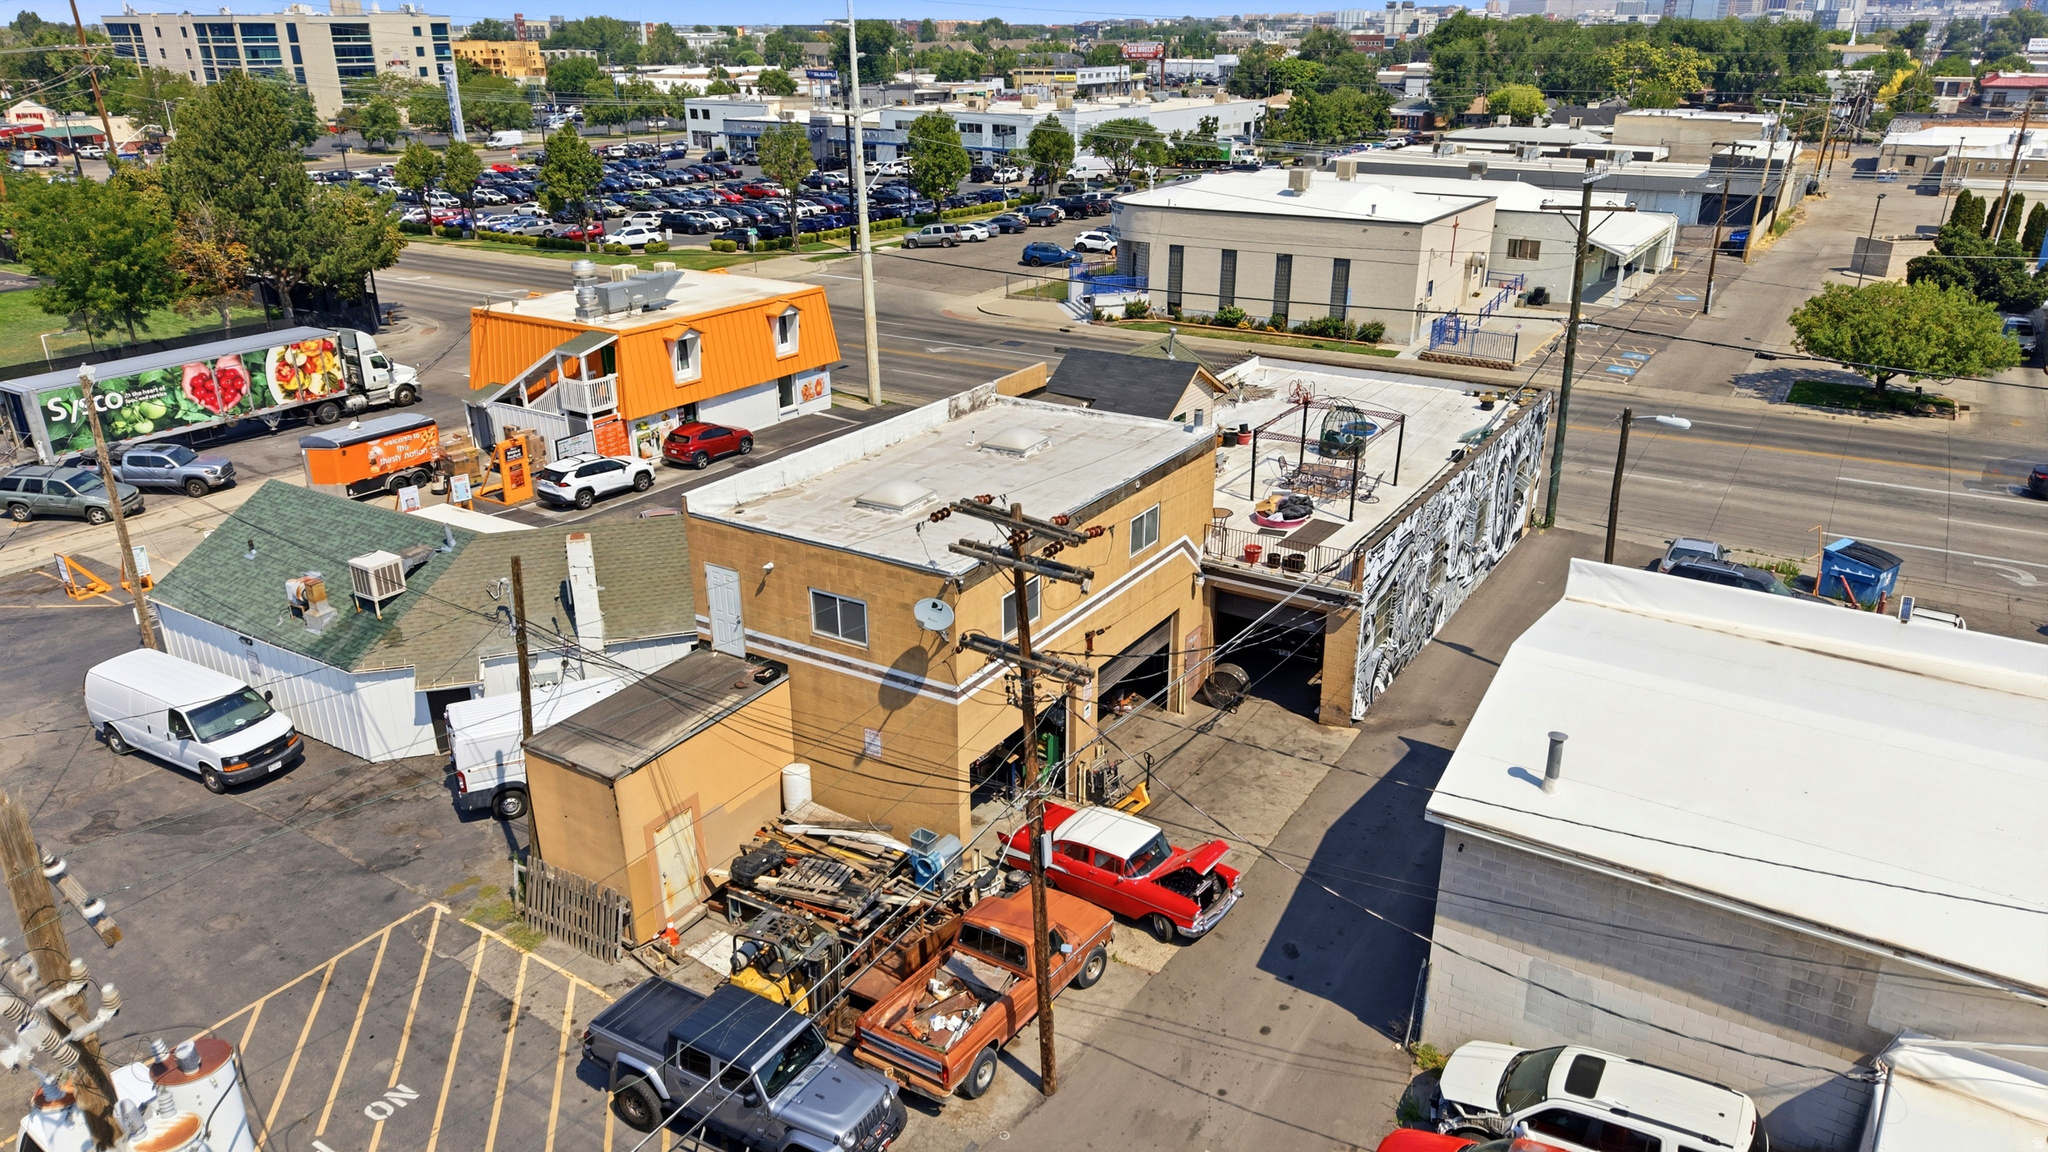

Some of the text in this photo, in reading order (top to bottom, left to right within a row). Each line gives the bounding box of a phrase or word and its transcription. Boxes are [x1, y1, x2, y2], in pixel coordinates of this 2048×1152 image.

[142, 387, 159, 395] heart
[383, 435, 412, 446] welcome
[396, 444, 409, 452] the
[380, 447, 428, 465] thirsty nation
